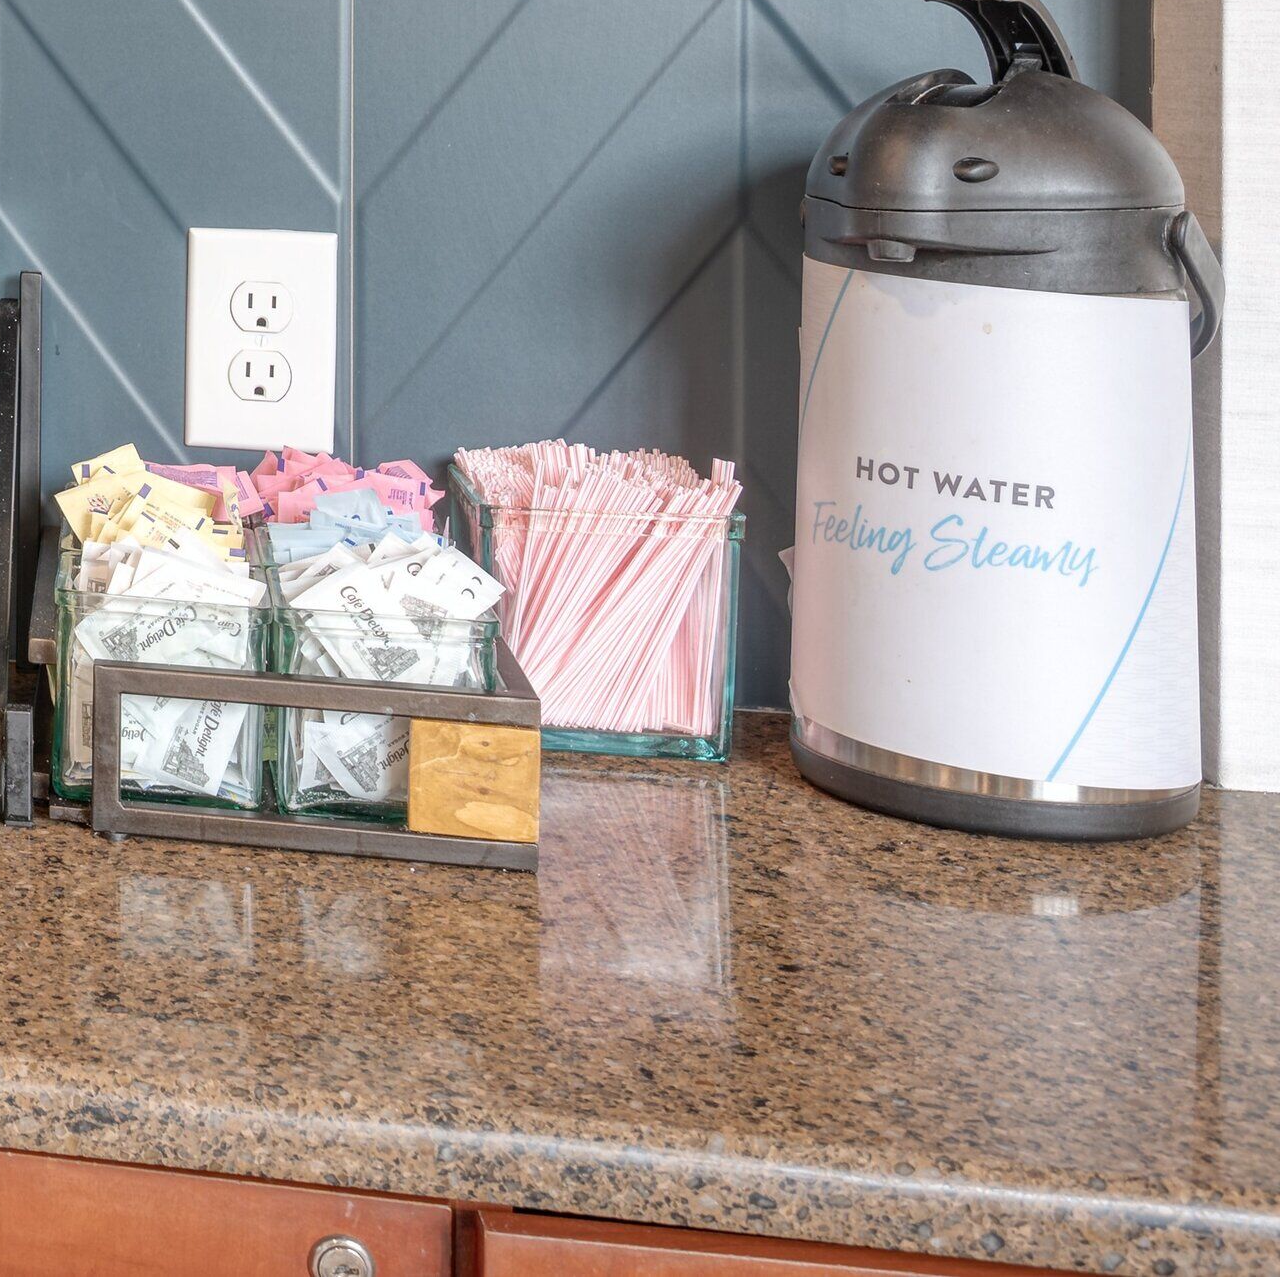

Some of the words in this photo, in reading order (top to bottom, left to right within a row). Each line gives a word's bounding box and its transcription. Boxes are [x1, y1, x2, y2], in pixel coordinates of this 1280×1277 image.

[855, 456, 920, 490] HOT
[933, 471, 1056, 509] WATER
[812, 501, 917, 575] Feeling
[924, 514, 1100, 588] Steamy
[340, 585, 364, 609] Café
[210, 701, 222, 721] afé
